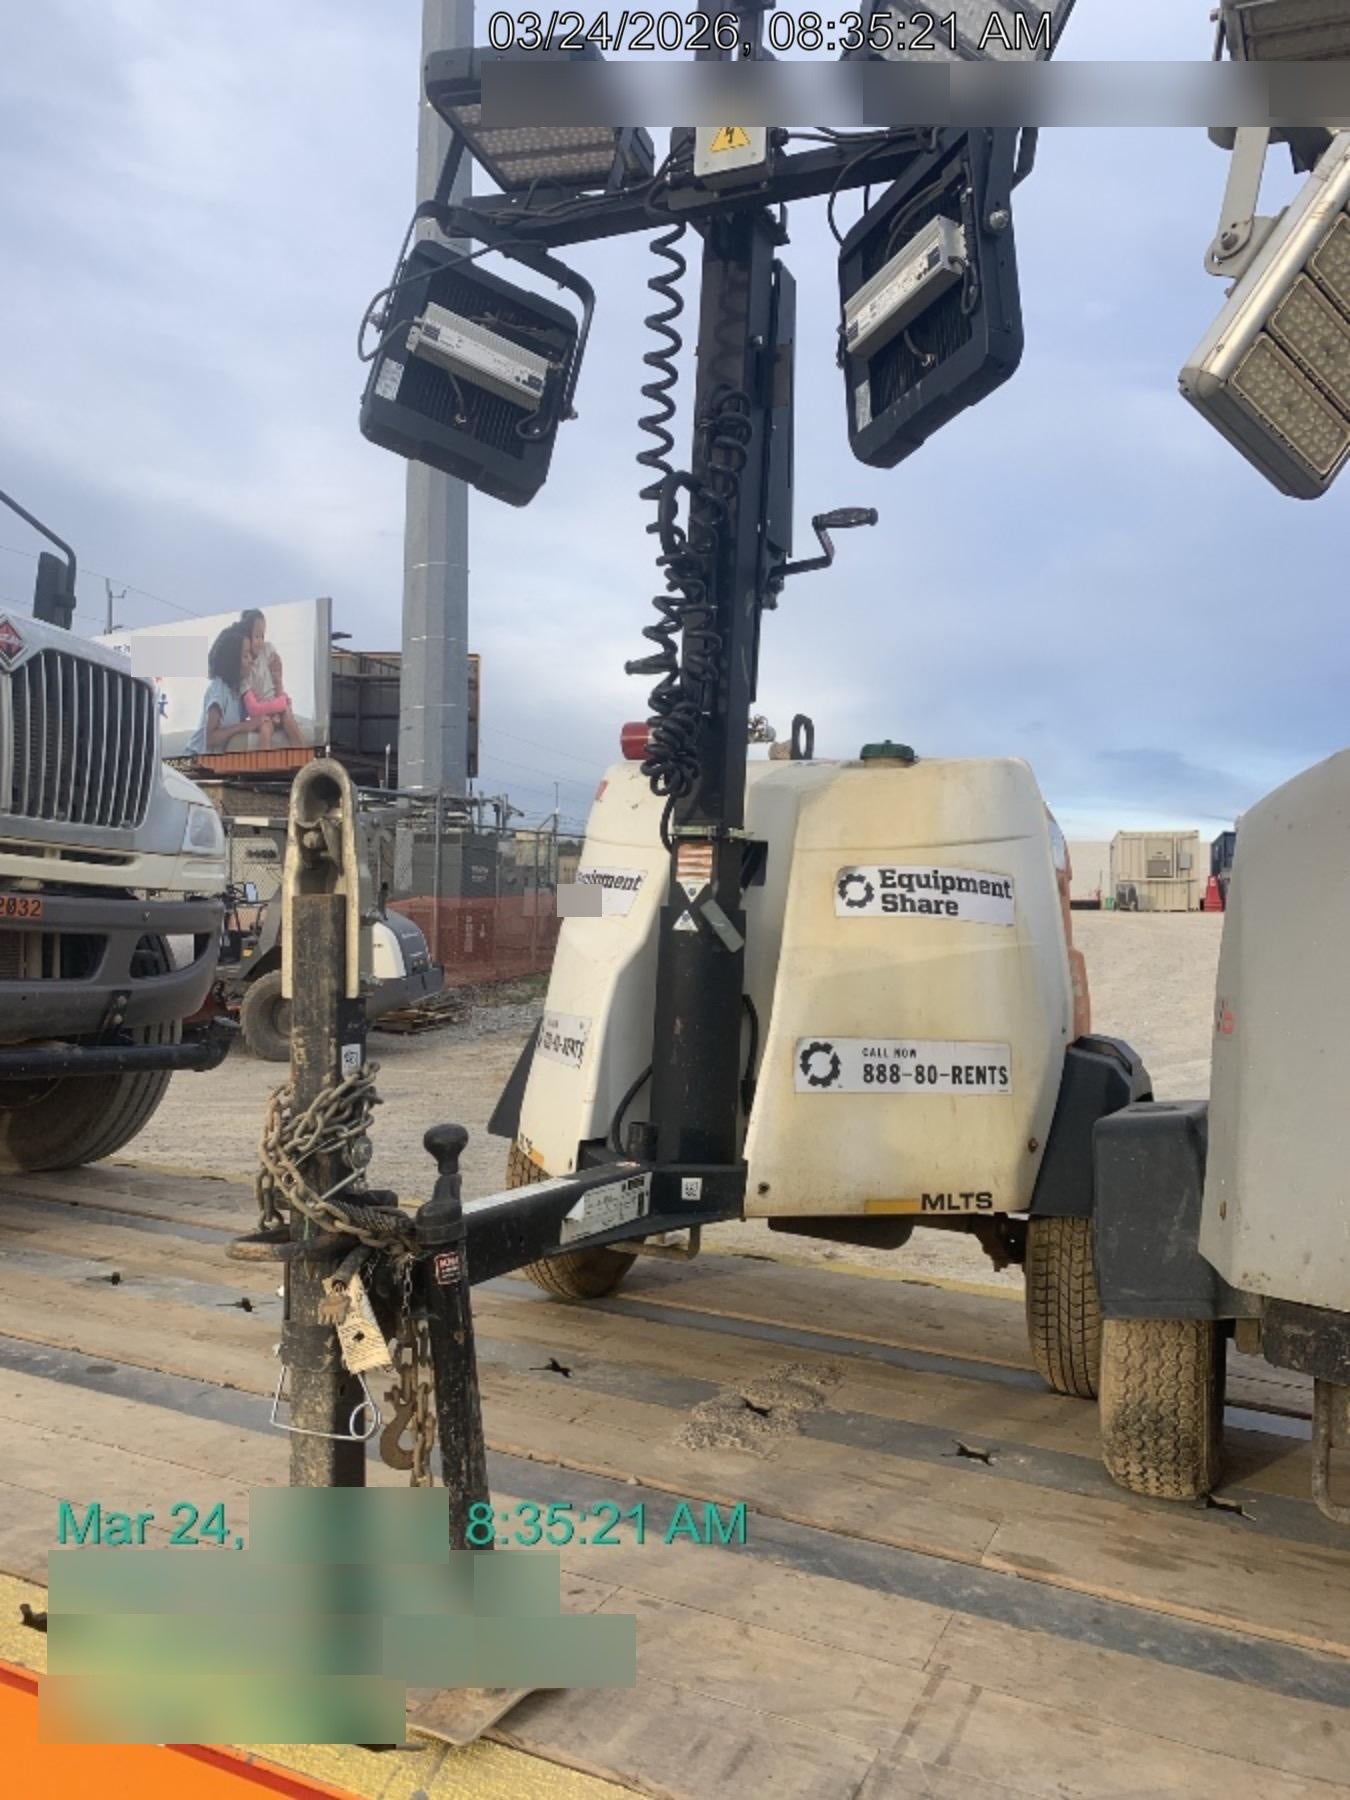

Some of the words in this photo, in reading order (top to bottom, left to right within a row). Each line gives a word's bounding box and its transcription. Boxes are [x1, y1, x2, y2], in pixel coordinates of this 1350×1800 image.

[878, 869, 1012, 899] Equipment
[881, 893, 959, 916] Share
[862, 1047, 888, 1058] CALL
[893, 1047, 917, 1059] NOW
[863, 1063, 1009, 1086] 888-80-RENTS
[921, 1192, 993, 1211] MLTS
